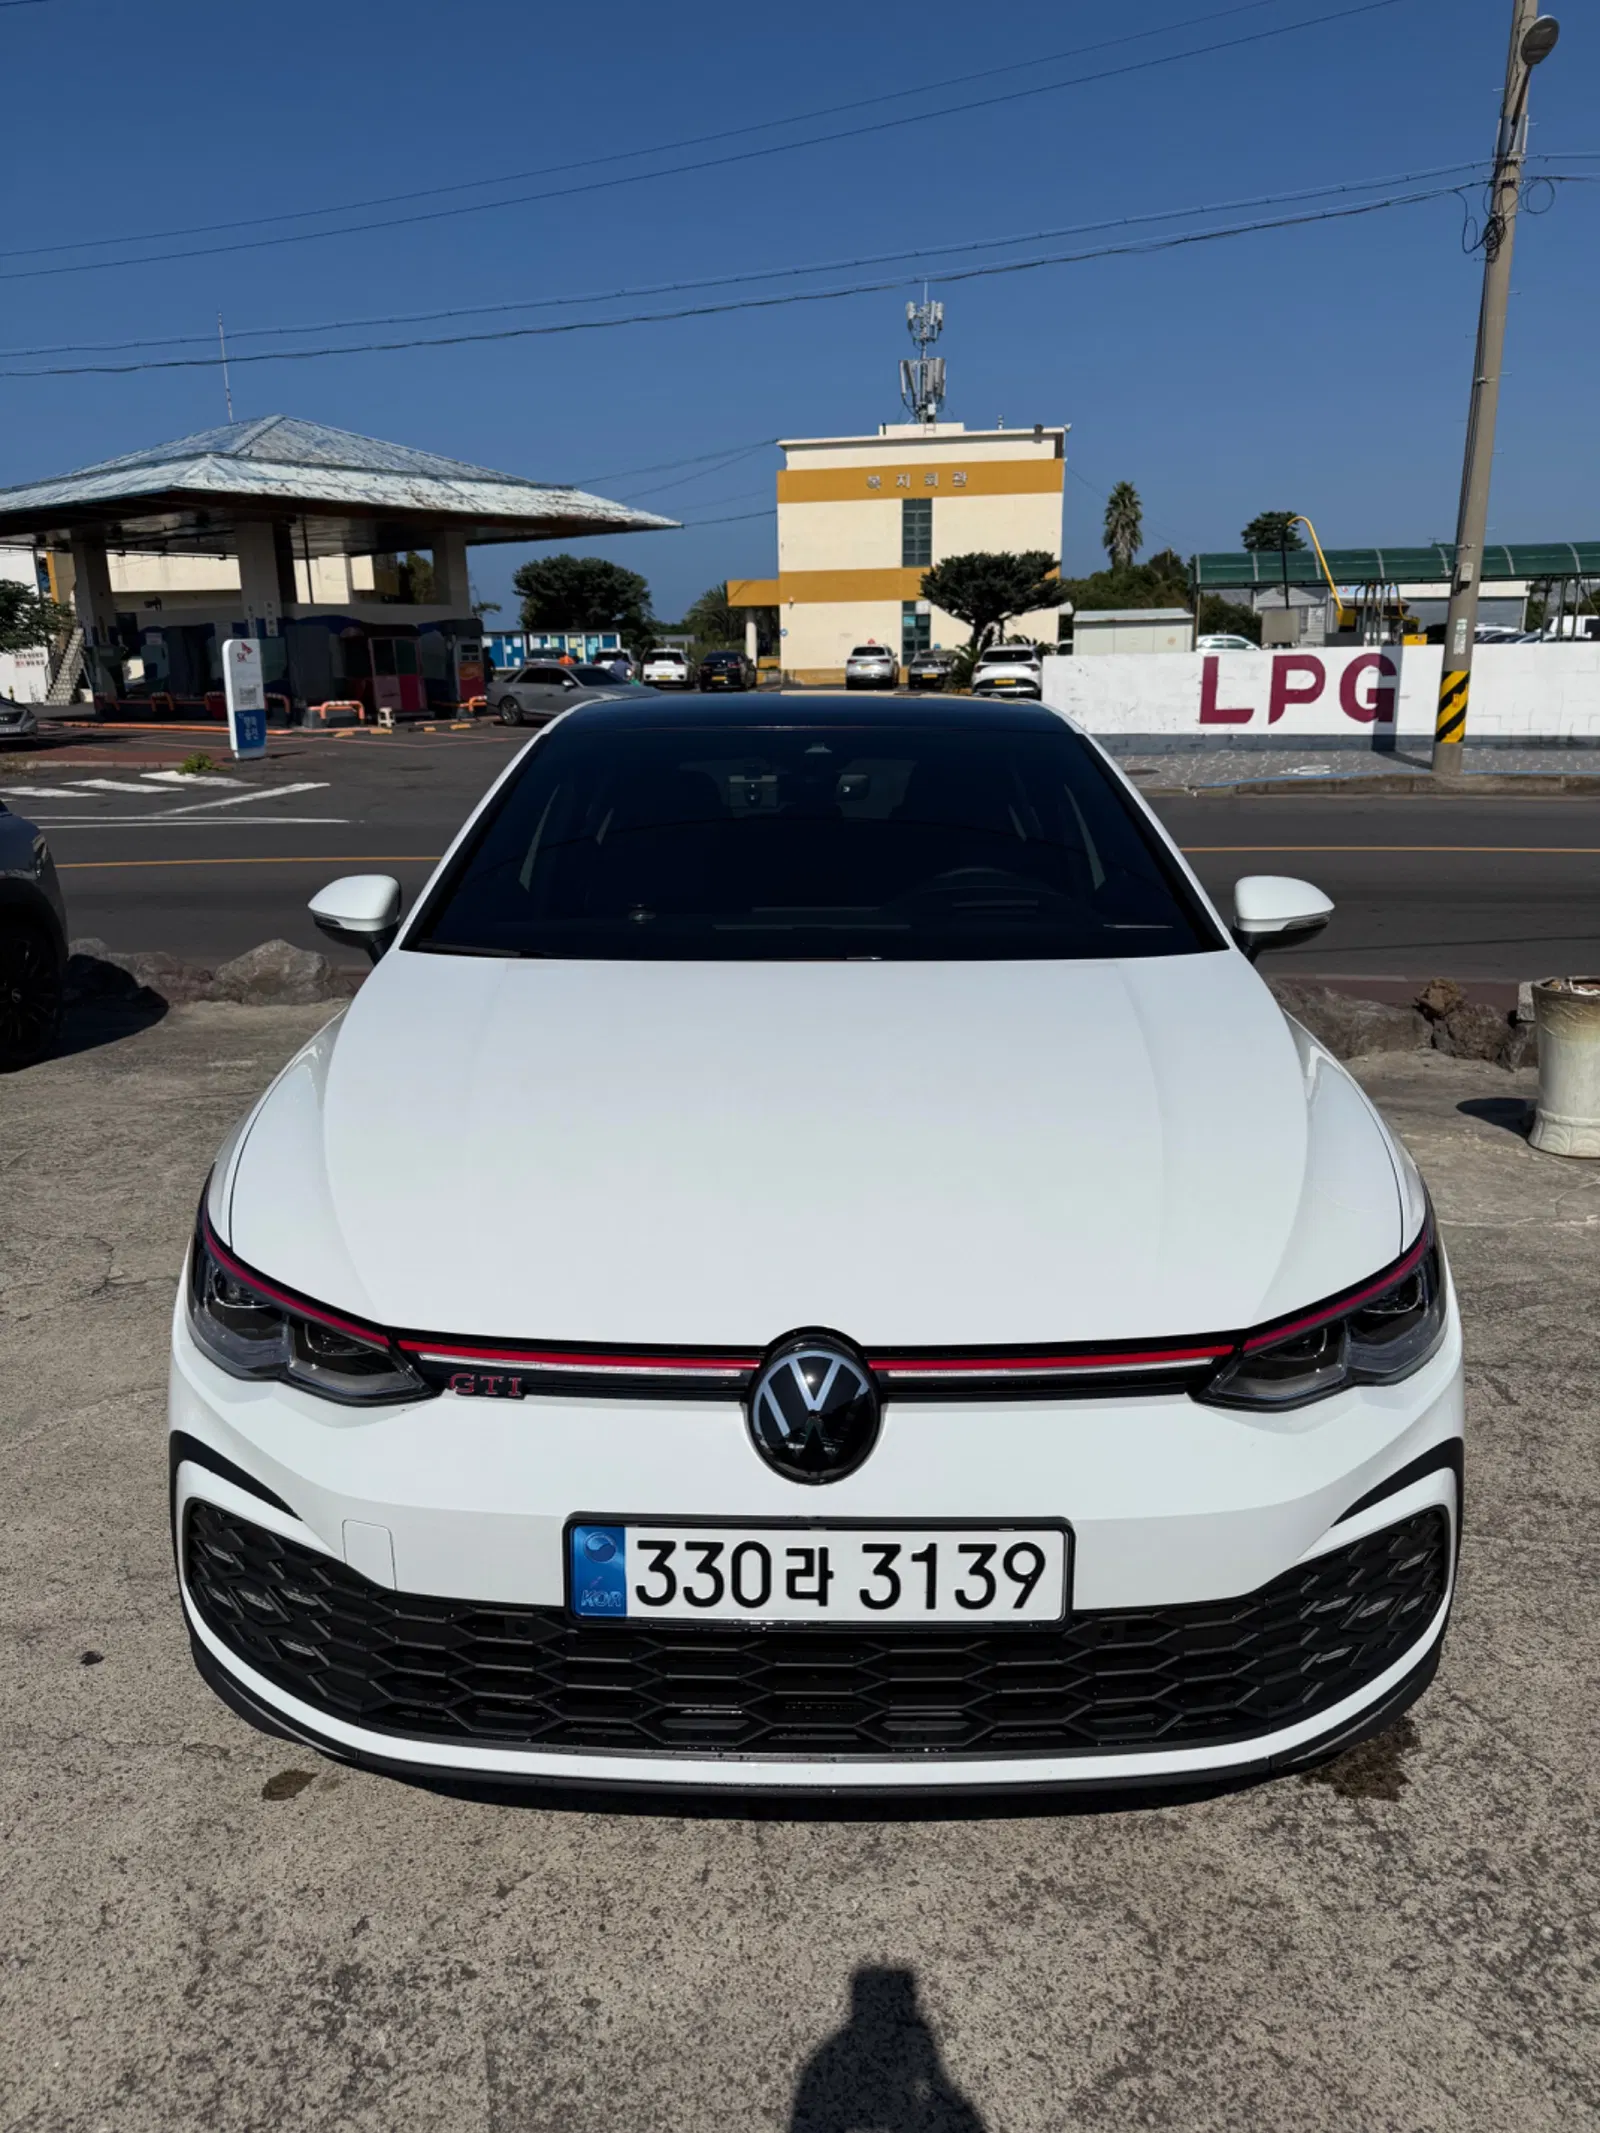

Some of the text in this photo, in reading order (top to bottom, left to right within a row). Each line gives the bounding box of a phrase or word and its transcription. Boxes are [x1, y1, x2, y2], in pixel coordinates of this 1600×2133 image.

[1200, 653, 1397, 725] LPG
[449, 1373, 522, 1397] GTI
[581, 1589, 622, 1608] KOR
[635, 1540, 1047, 1610] 330라 3139
